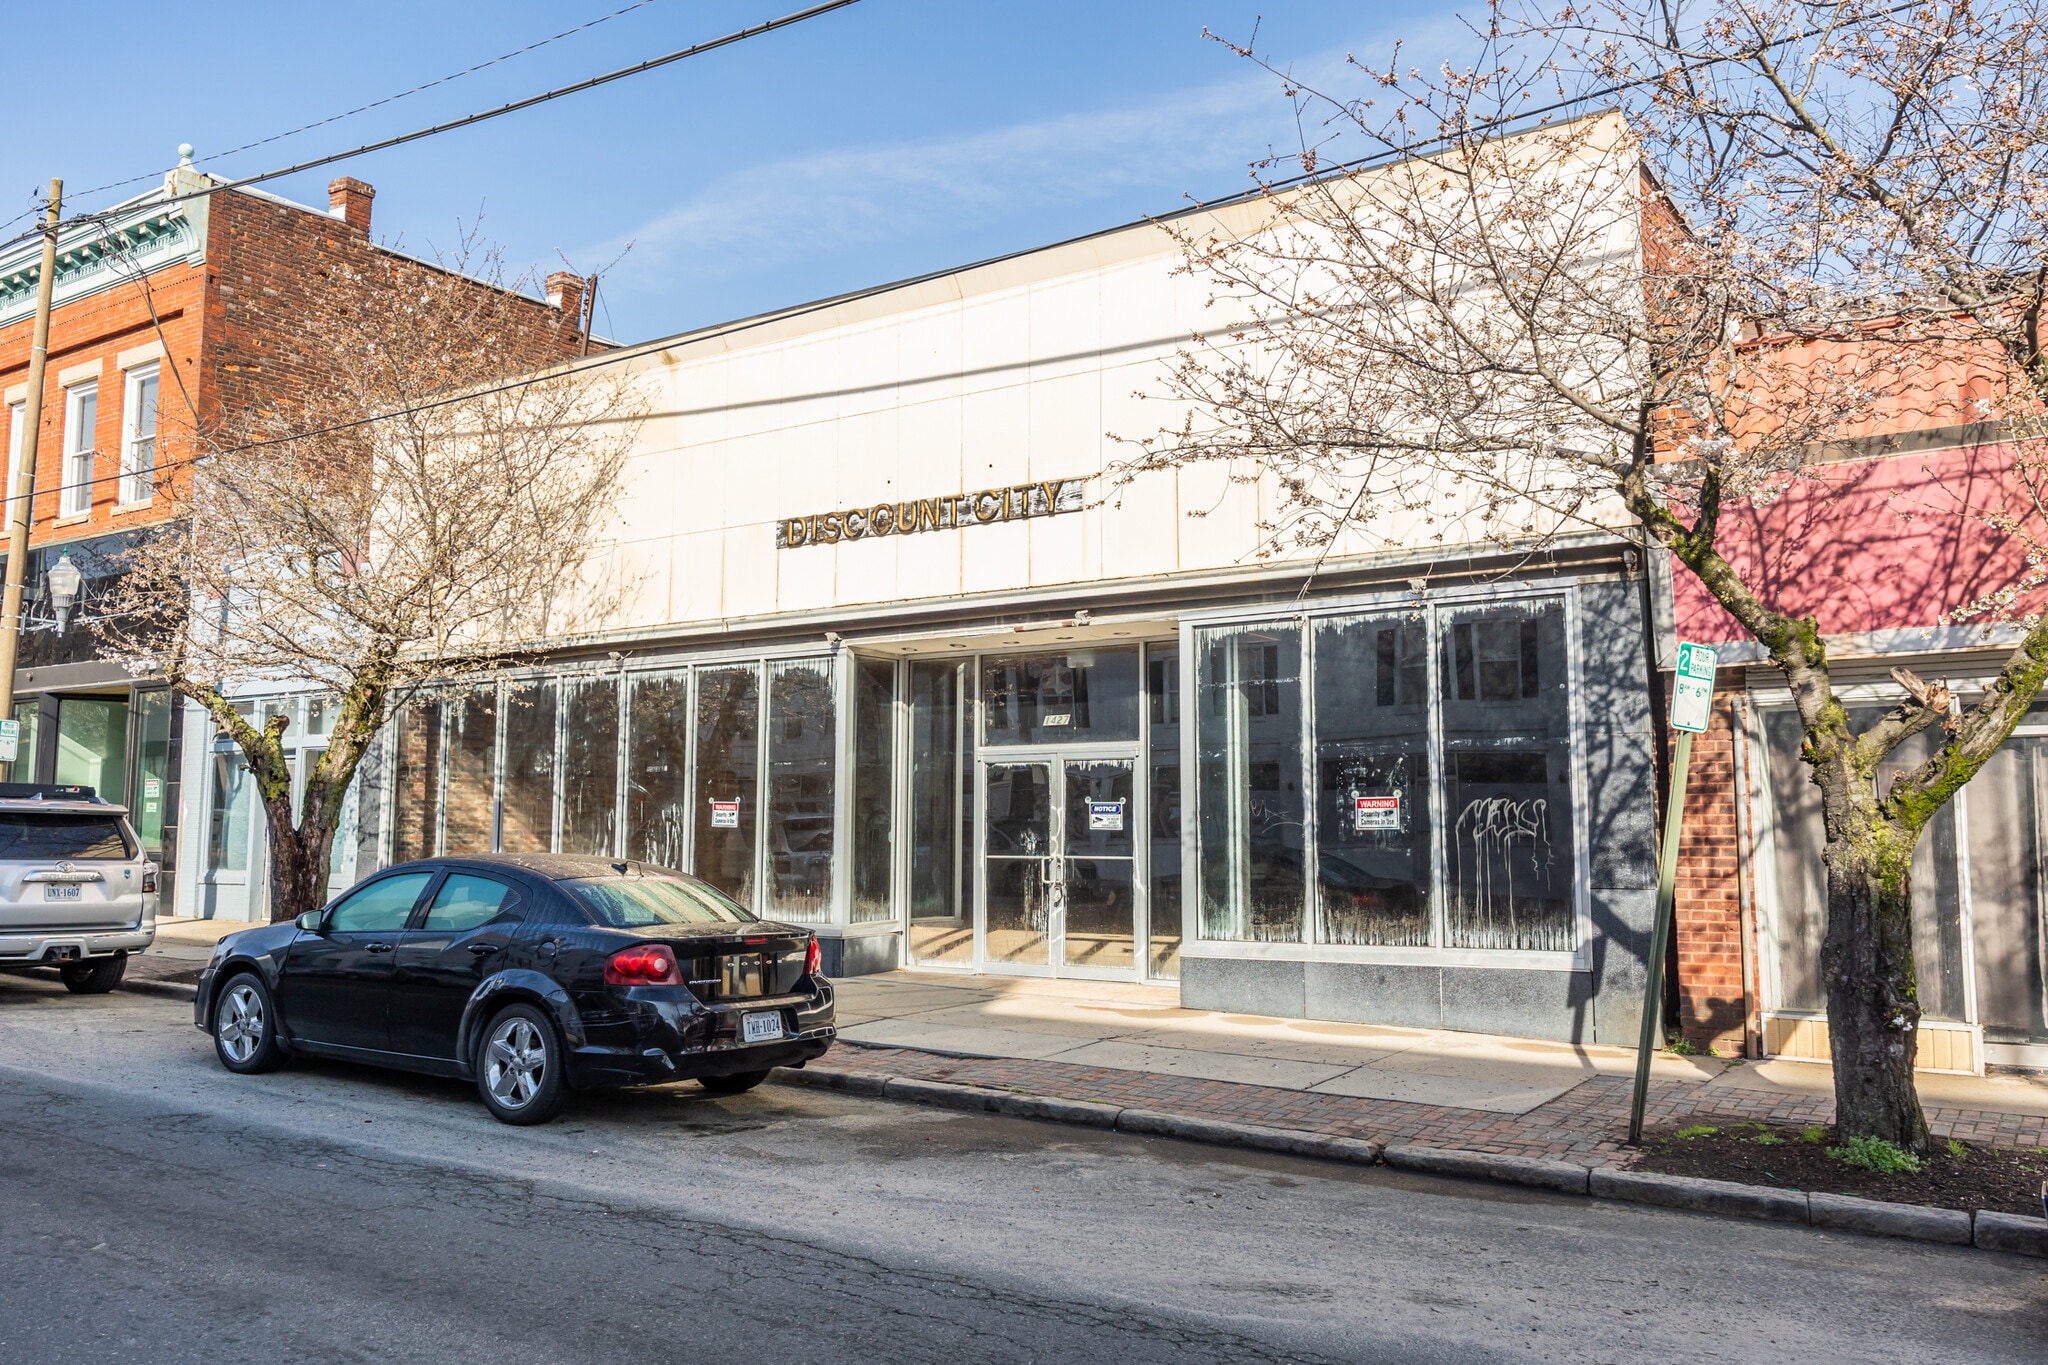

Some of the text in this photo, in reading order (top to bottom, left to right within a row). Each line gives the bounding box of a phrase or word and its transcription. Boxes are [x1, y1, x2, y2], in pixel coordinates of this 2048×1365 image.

[785, 479, 1066, 548] DISCOUNT CITY
[1680, 649, 1689, 671] 2
[1690, 662, 1711, 677] PARKING
[1045, 715, 1069, 724] 1427
[1360, 800, 1395, 808] WARNING
[1361, 810, 1380, 818] Security
